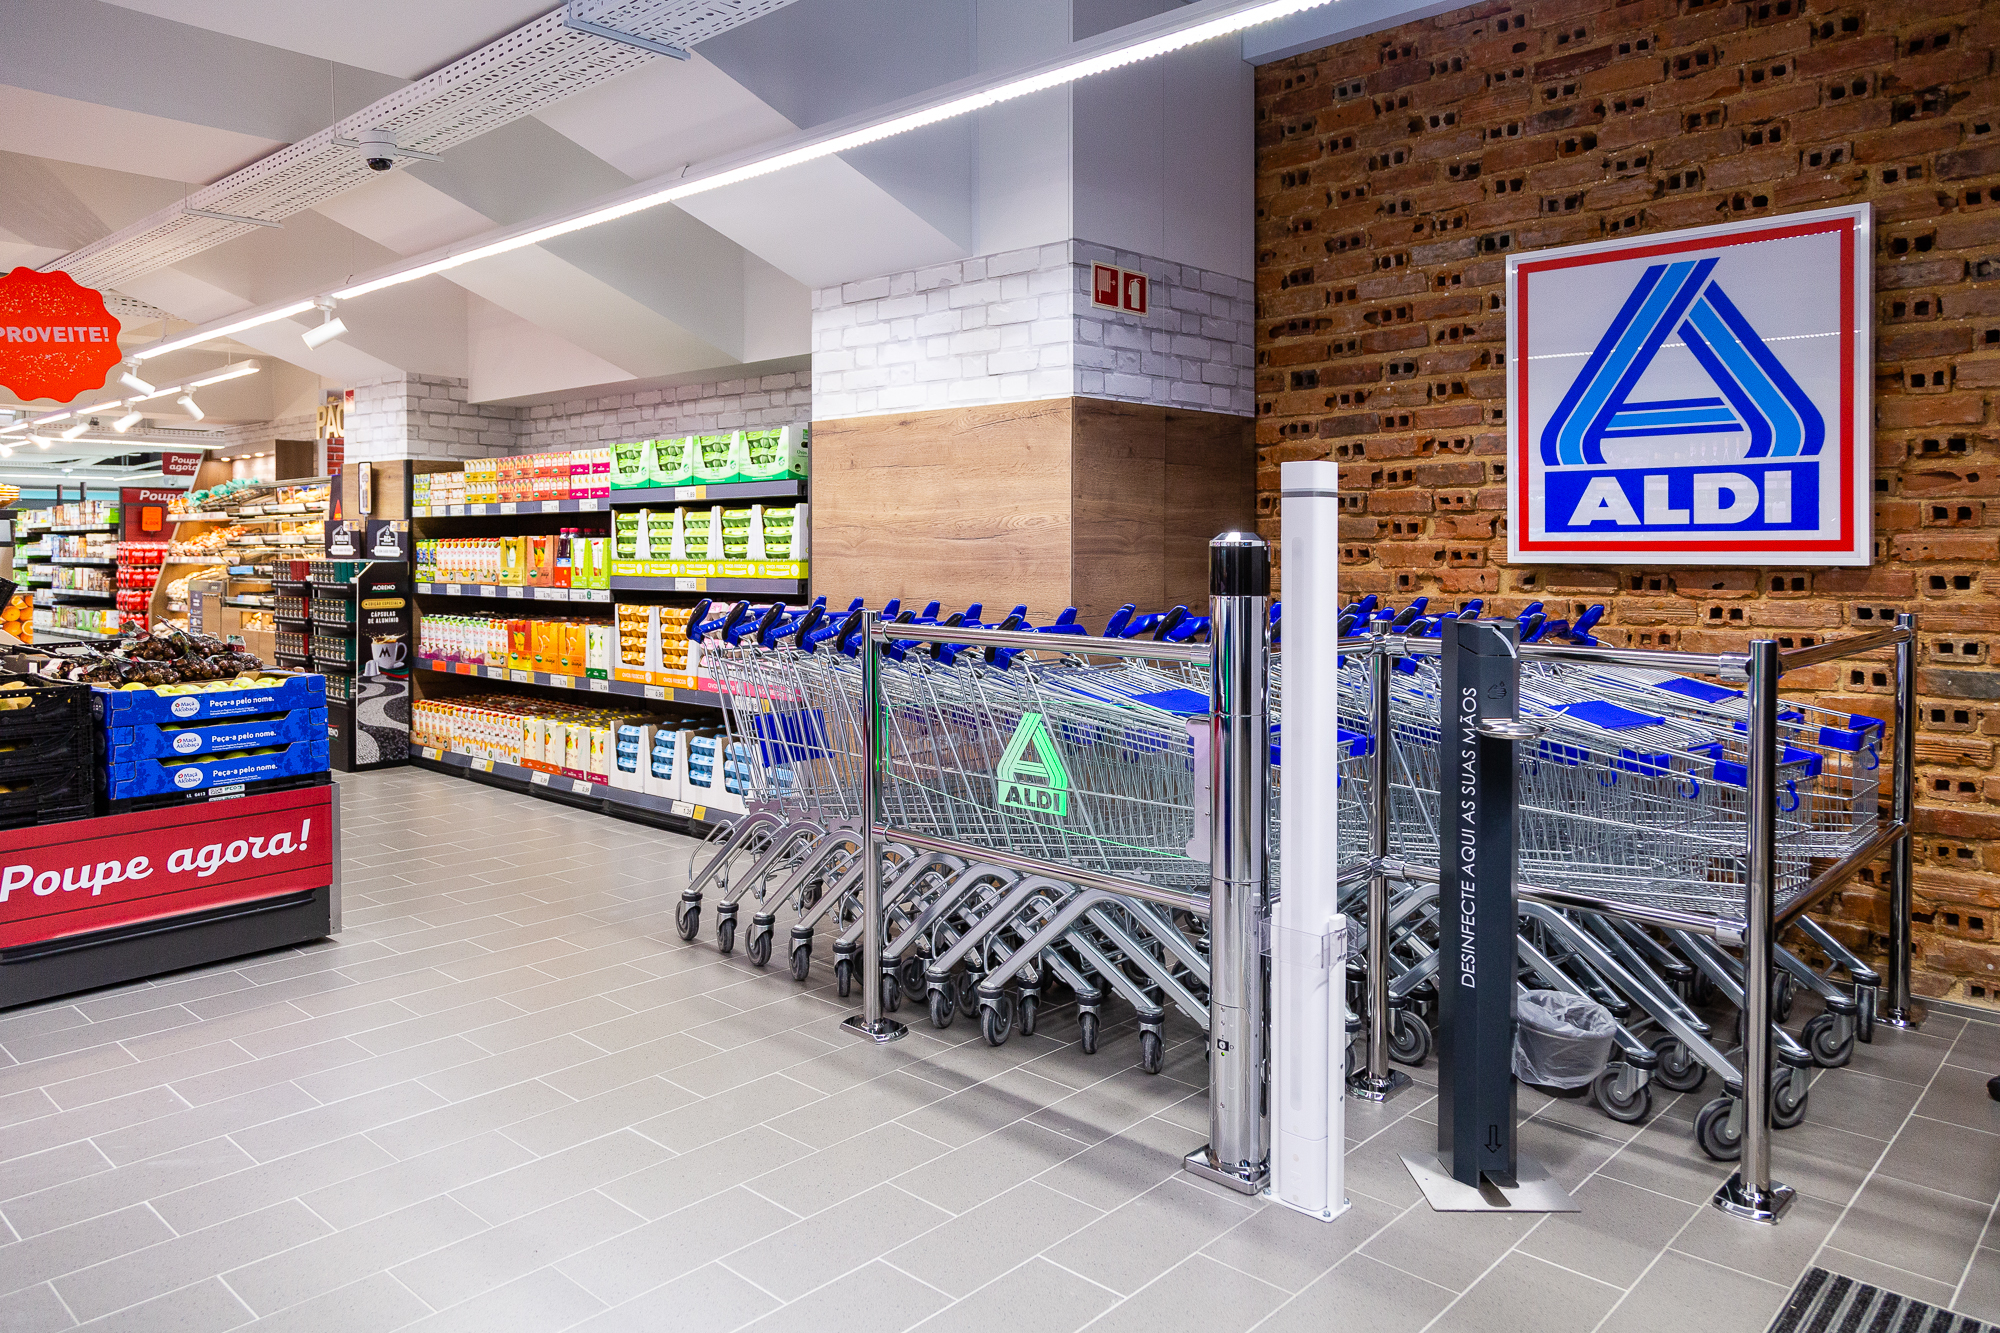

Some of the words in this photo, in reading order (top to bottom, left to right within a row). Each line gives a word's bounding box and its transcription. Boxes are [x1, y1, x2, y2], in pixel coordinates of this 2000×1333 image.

[1567, 470, 1792, 526] ALDI
[210, 700, 234, 708] Peça-a
[236, 697, 252, 706] pelo
[1460, 688, 1477, 745] MÃOS
[238, 732, 254, 741] pelo
[239, 766, 255, 775] pelo
[1462, 750, 1476, 796] SUAS
[1004, 786, 1059, 812] ALDI
[1462, 800, 1476, 824] AS
[0, 864, 154, 902] Poupe
[167, 818, 310, 877] agora!
[1461, 829, 1476, 877] AQUI
[1461, 880, 1476, 988] DESINFECTE
